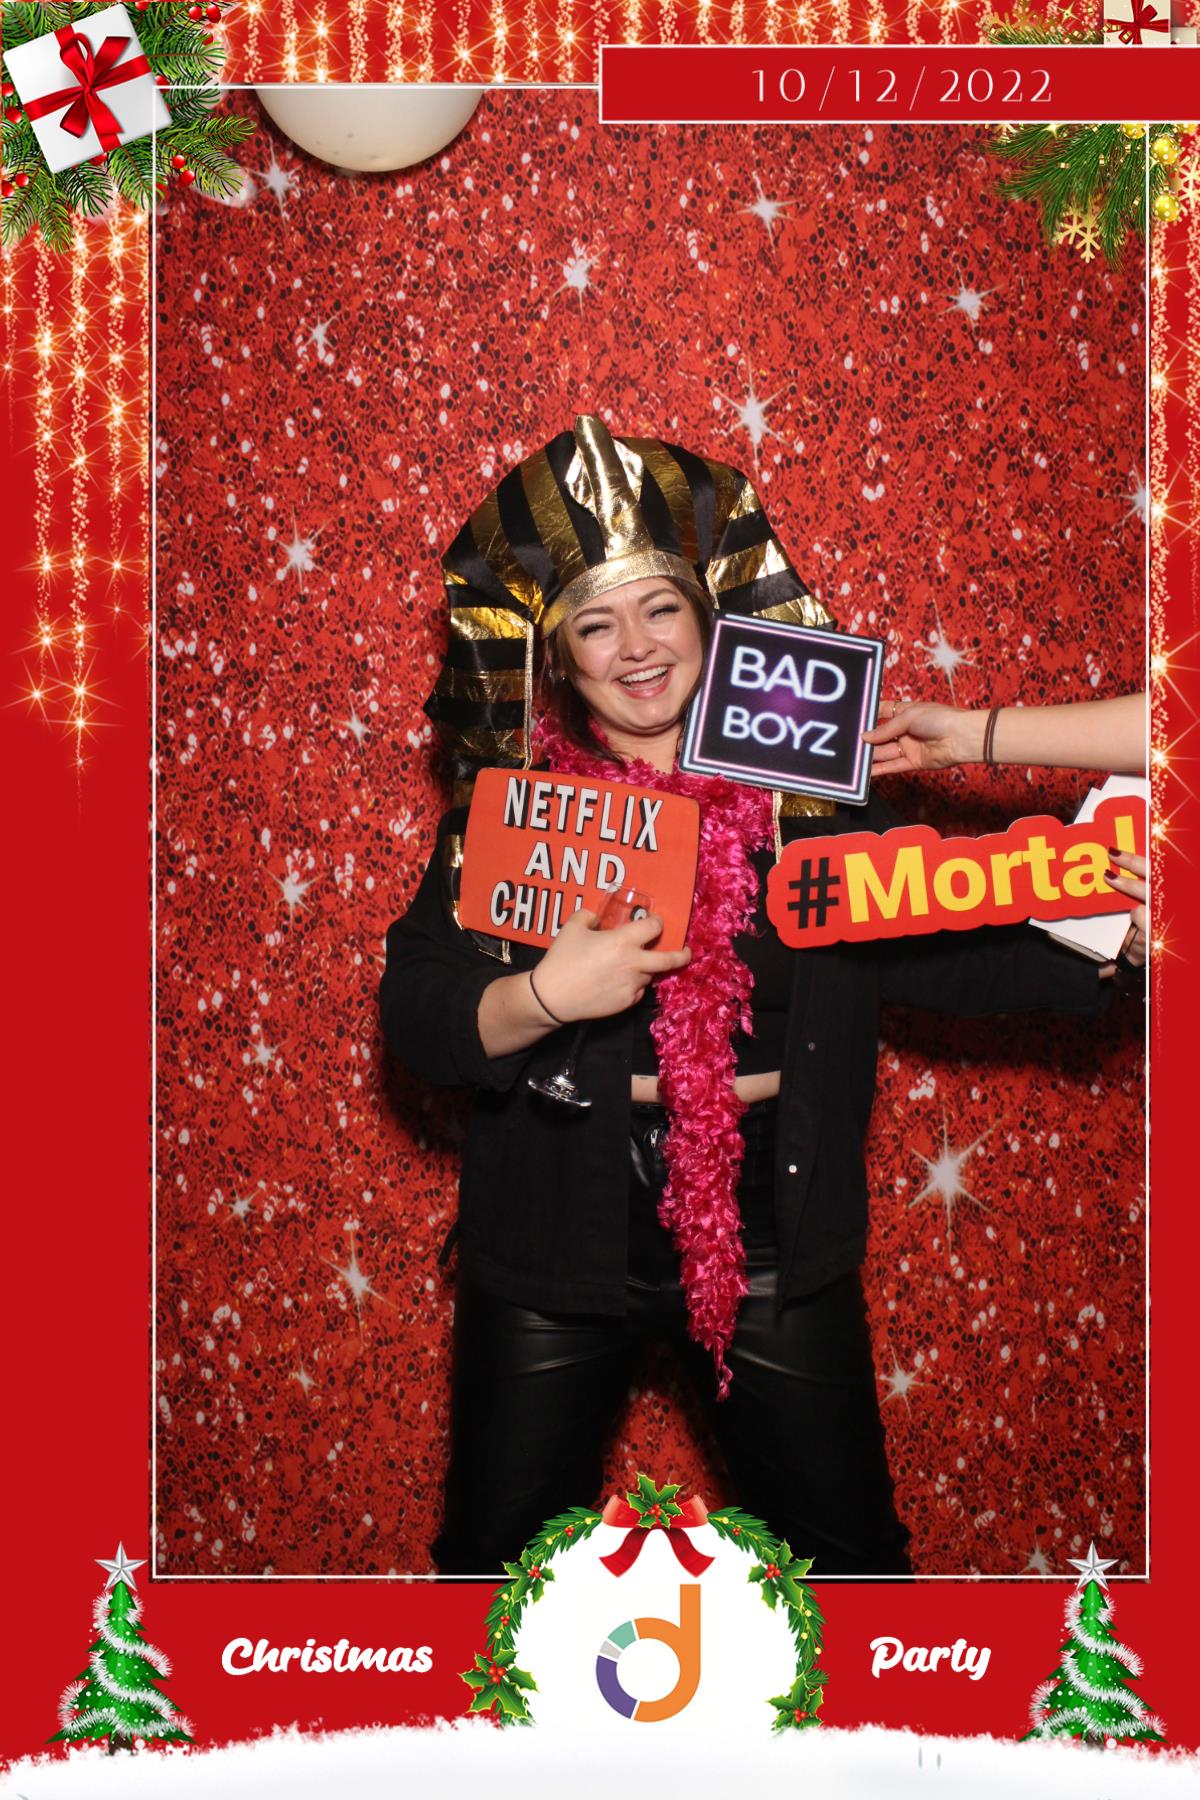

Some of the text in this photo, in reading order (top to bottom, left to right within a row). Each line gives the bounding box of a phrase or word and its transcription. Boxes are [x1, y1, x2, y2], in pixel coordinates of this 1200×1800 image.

[730, 645, 847, 703] BAD
[721, 705, 839, 757] BOYZ
[503, 776, 663, 851] NETFLIX
[524, 841, 627, 892] AND
[786, 815, 1138, 930] #Mortal
